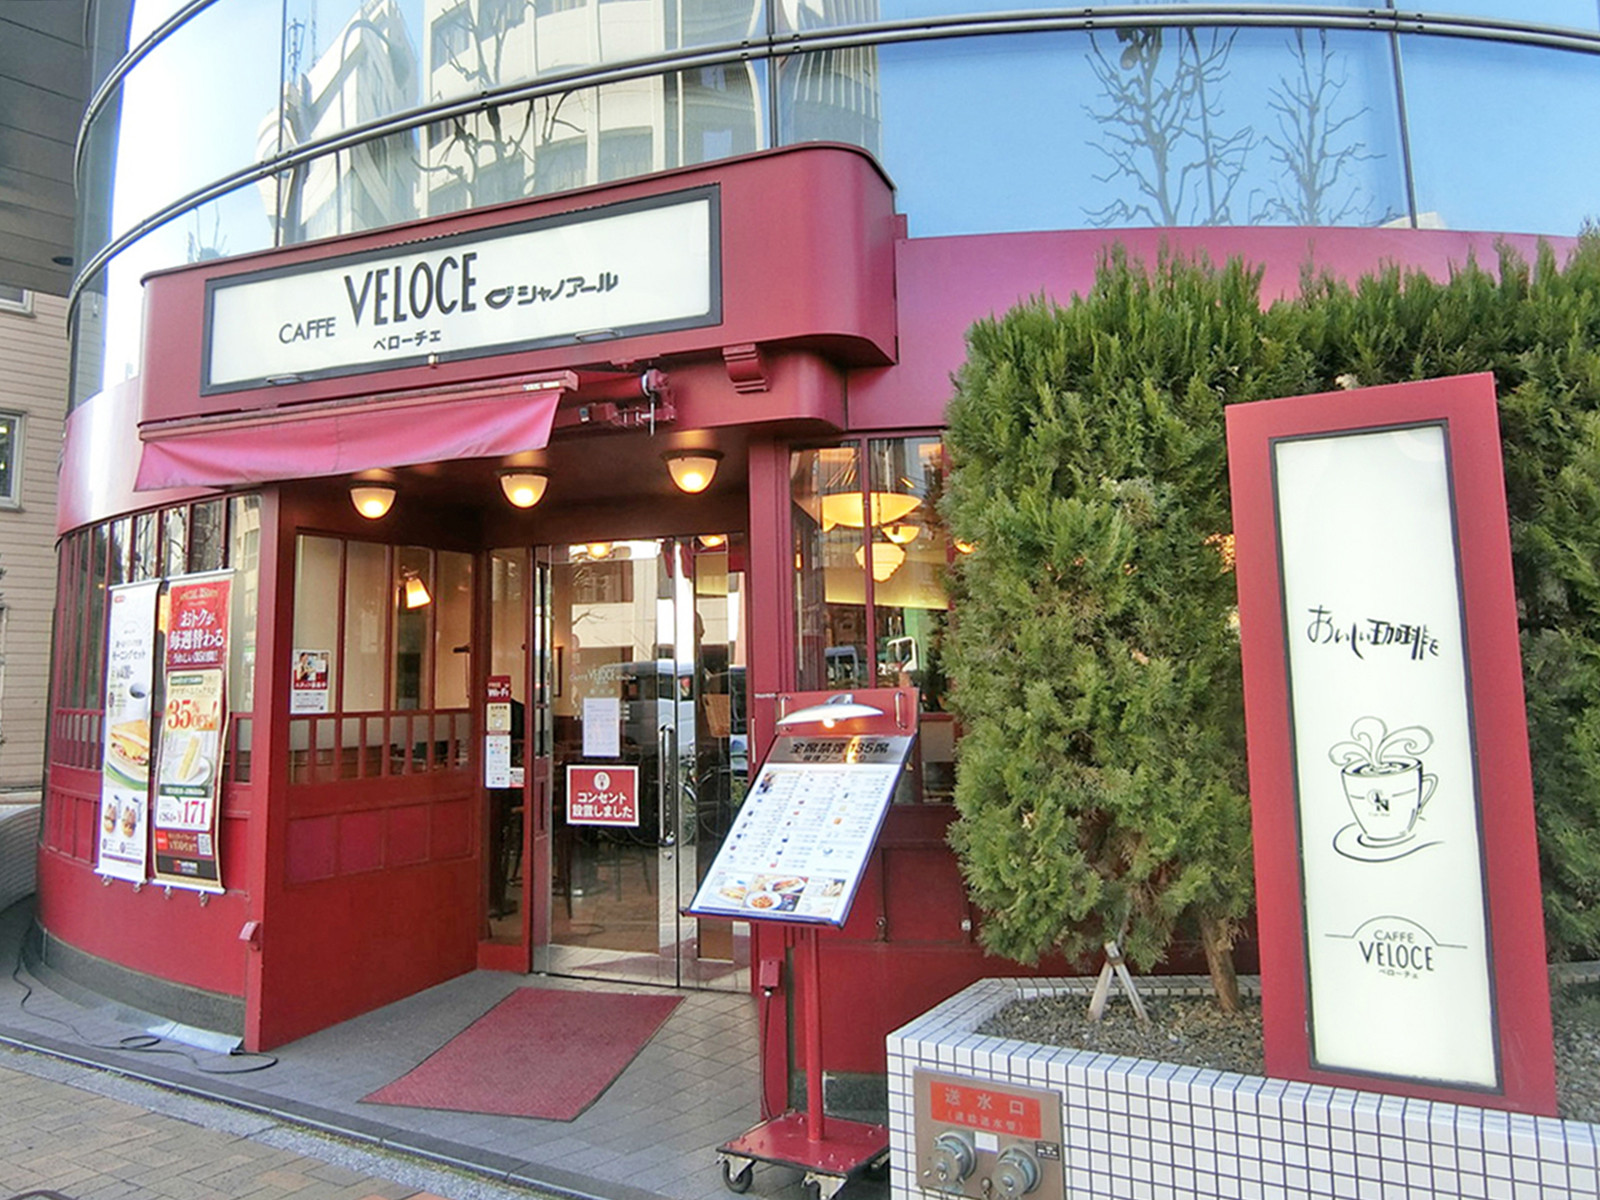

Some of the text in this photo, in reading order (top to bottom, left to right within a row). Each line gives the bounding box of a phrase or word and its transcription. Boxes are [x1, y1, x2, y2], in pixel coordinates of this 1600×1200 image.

[279, 252, 478, 344] CAFFE VELOCE
[517, 272, 618, 305] シャノアール
[1307, 605, 1439, 660] おいしい珈琲を
[572, 803, 633, 818] 設置しました
[577, 791, 627, 805] コンセント
[1374, 929, 1414, 943] CAFFE
[1359, 940, 1434, 971] VELOCE
[945, 1087, 1025, 1115] 送水口
